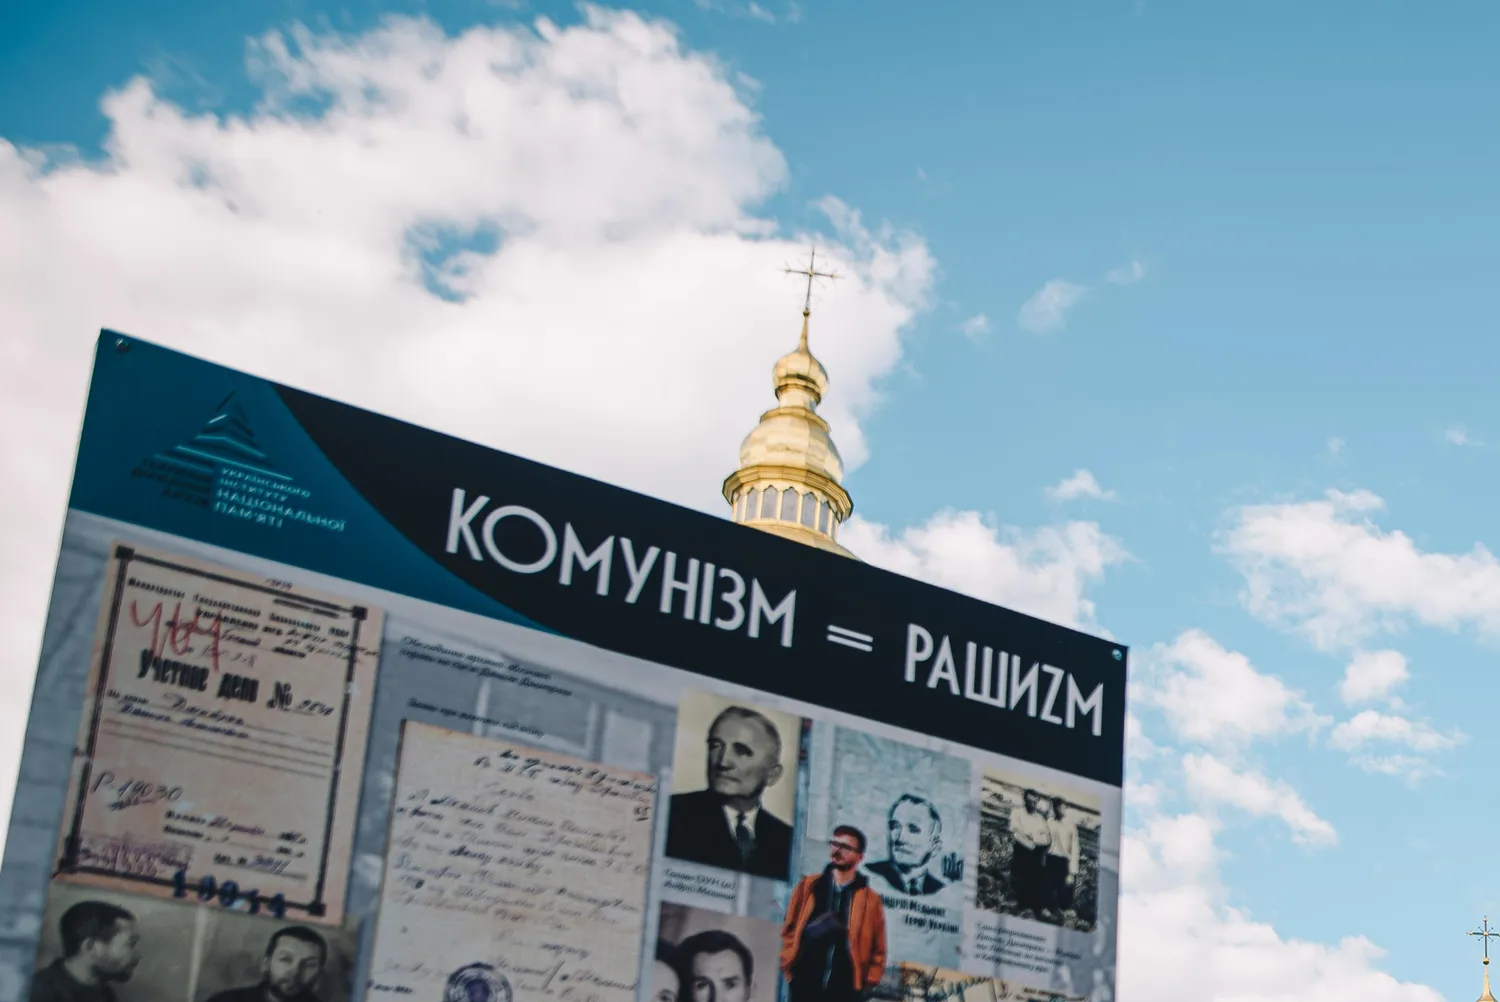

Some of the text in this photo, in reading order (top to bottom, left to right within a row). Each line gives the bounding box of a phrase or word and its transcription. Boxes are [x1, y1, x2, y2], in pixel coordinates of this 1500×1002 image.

[221, 467, 311, 498] УКРАЇНСЬКОГО
[216, 488, 346, 532] НАЦІОНАЛЬНОЇ
[446, 487, 797, 648] КОМУНІЗМ
